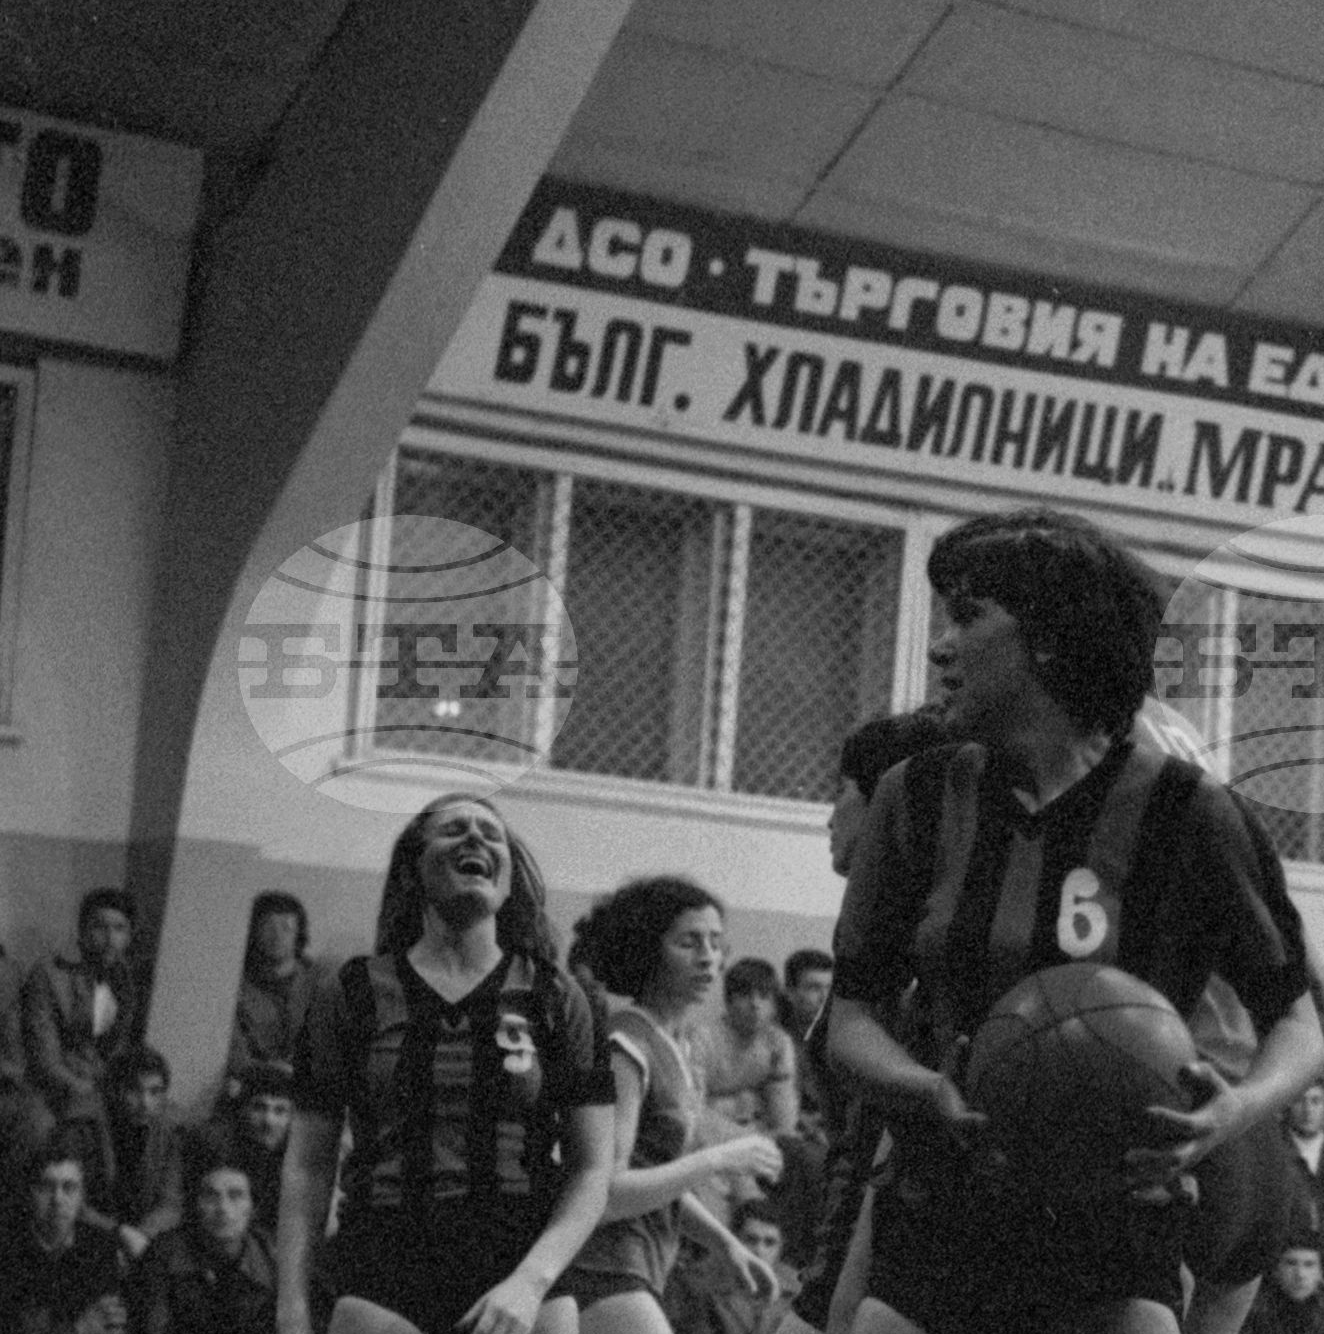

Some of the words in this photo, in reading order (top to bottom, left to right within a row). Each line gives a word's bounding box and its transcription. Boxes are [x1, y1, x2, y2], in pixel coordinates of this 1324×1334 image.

[531, 206, 693, 287] ДСО
[745, 244, 1124, 367] ТЪРГОВИЯ
[1141, 321, 1230, 387] НА
[494, 299, 692, 412] БЪЛГ.
[721, 341, 1164, 493] ХЛАДИЛНИЦИ
[1056, 867, 1107, 957] 6
